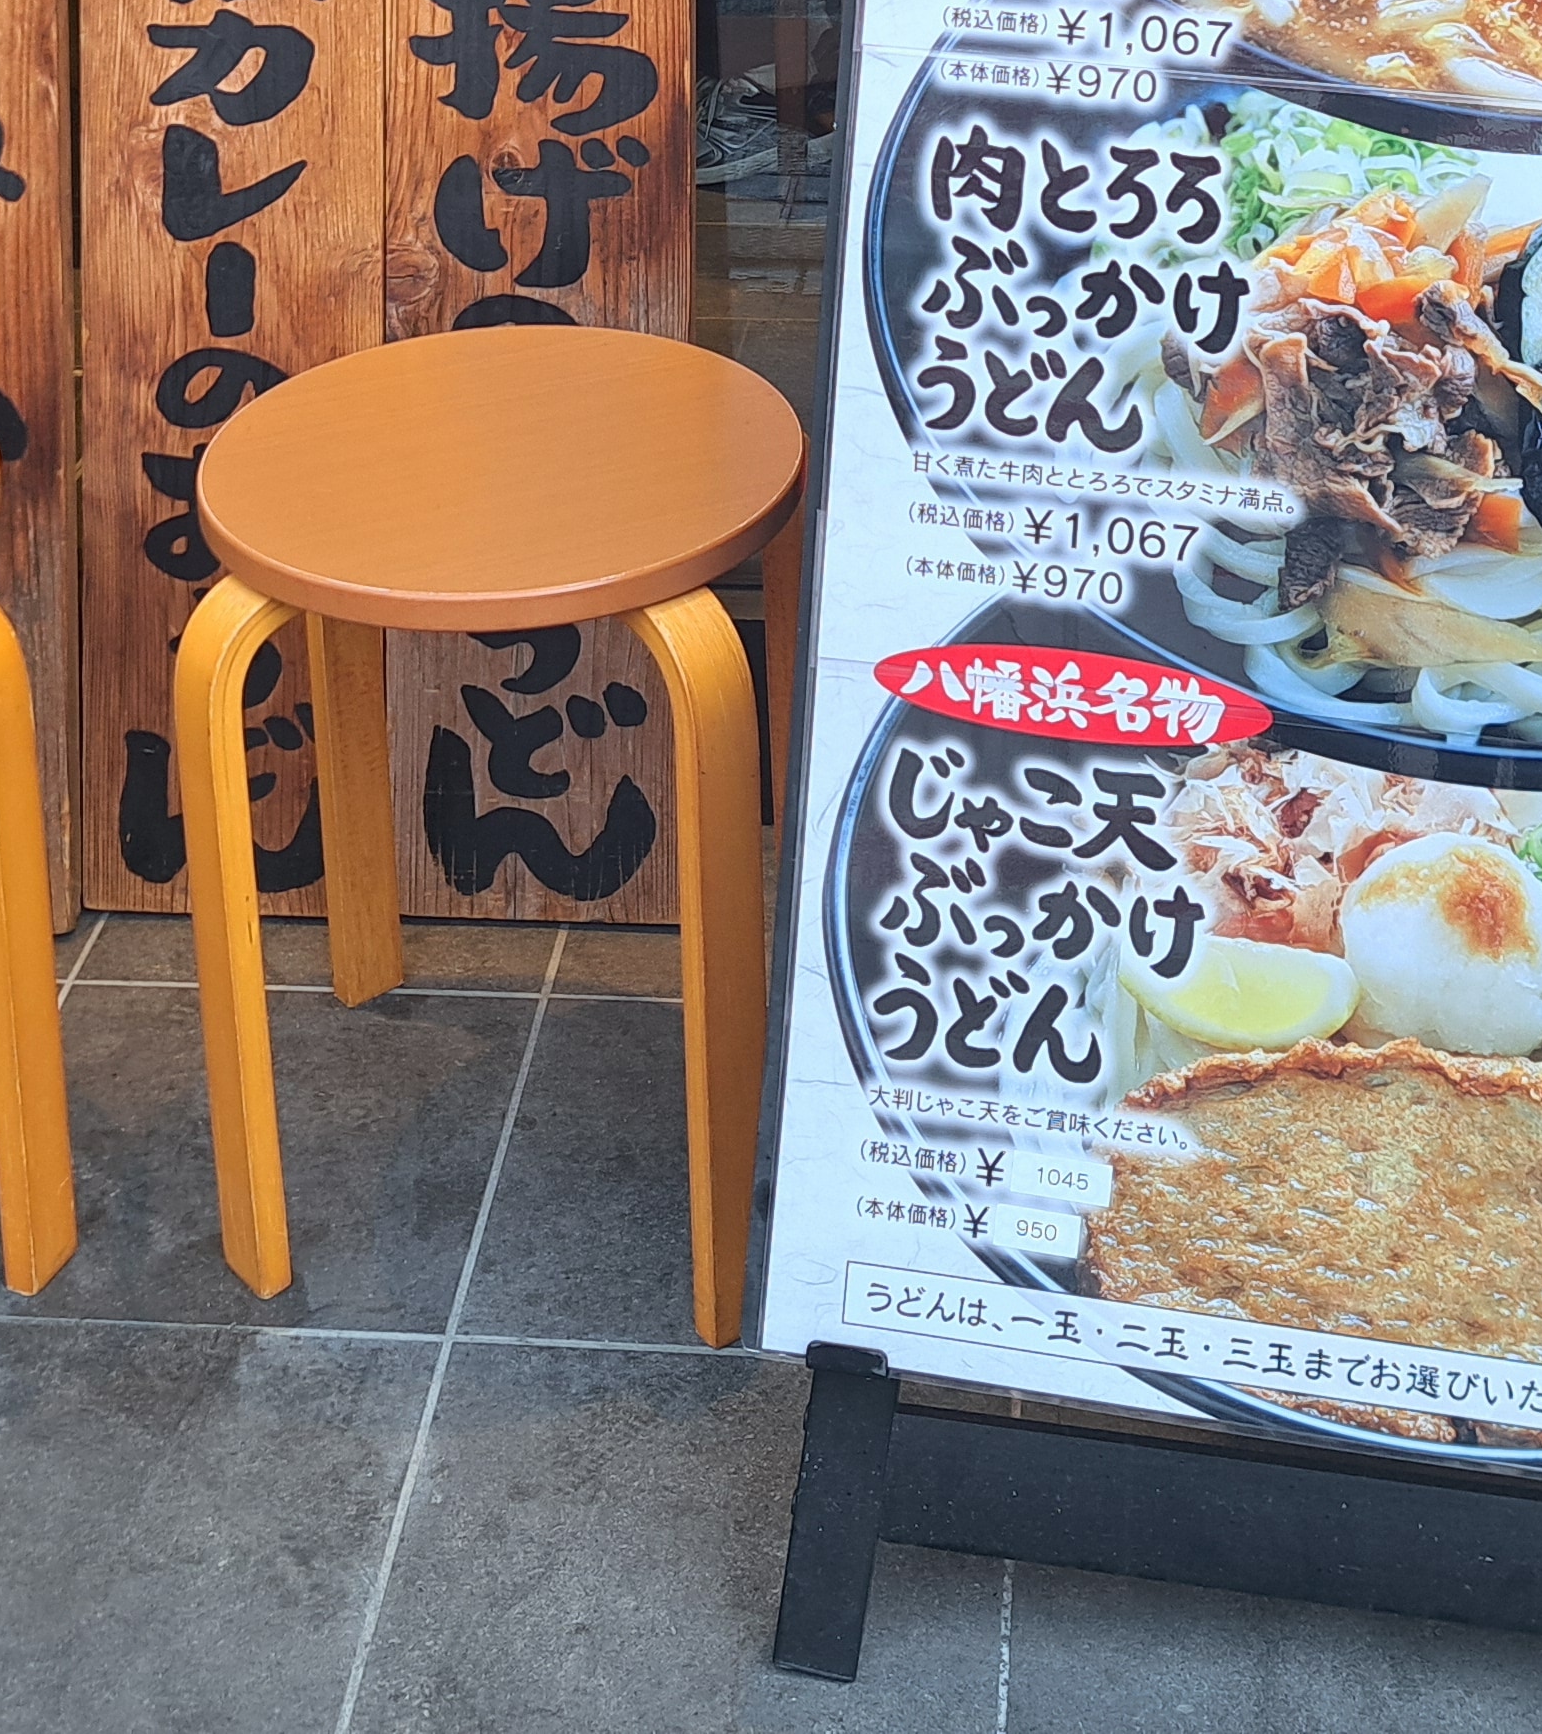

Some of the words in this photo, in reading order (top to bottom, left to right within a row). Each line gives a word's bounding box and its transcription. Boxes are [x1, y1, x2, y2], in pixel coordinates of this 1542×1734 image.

[931, 124, 1222, 244] 肉とろろ
[921, 235, 1250, 354] ぶっかけ
[917, 335, 1143, 454] うどん
[911, 450, 1295, 515] 甘く煮た牛肉ととろろでスタミナ満点。
[901, 657, 1225, 745] 八幡浜名物
[888, 747, 1178, 872] じゃこ天
[880, 852, 1205, 979] ぶっかけ
[873, 953, 1102, 1083] うどん
[868, 1084, 1189, 1151] 大判じゃこ天をご賞味ください。
[1015, 1219, 1058, 1241] 950
[1036, 1166, 1090, 1191] 1045
